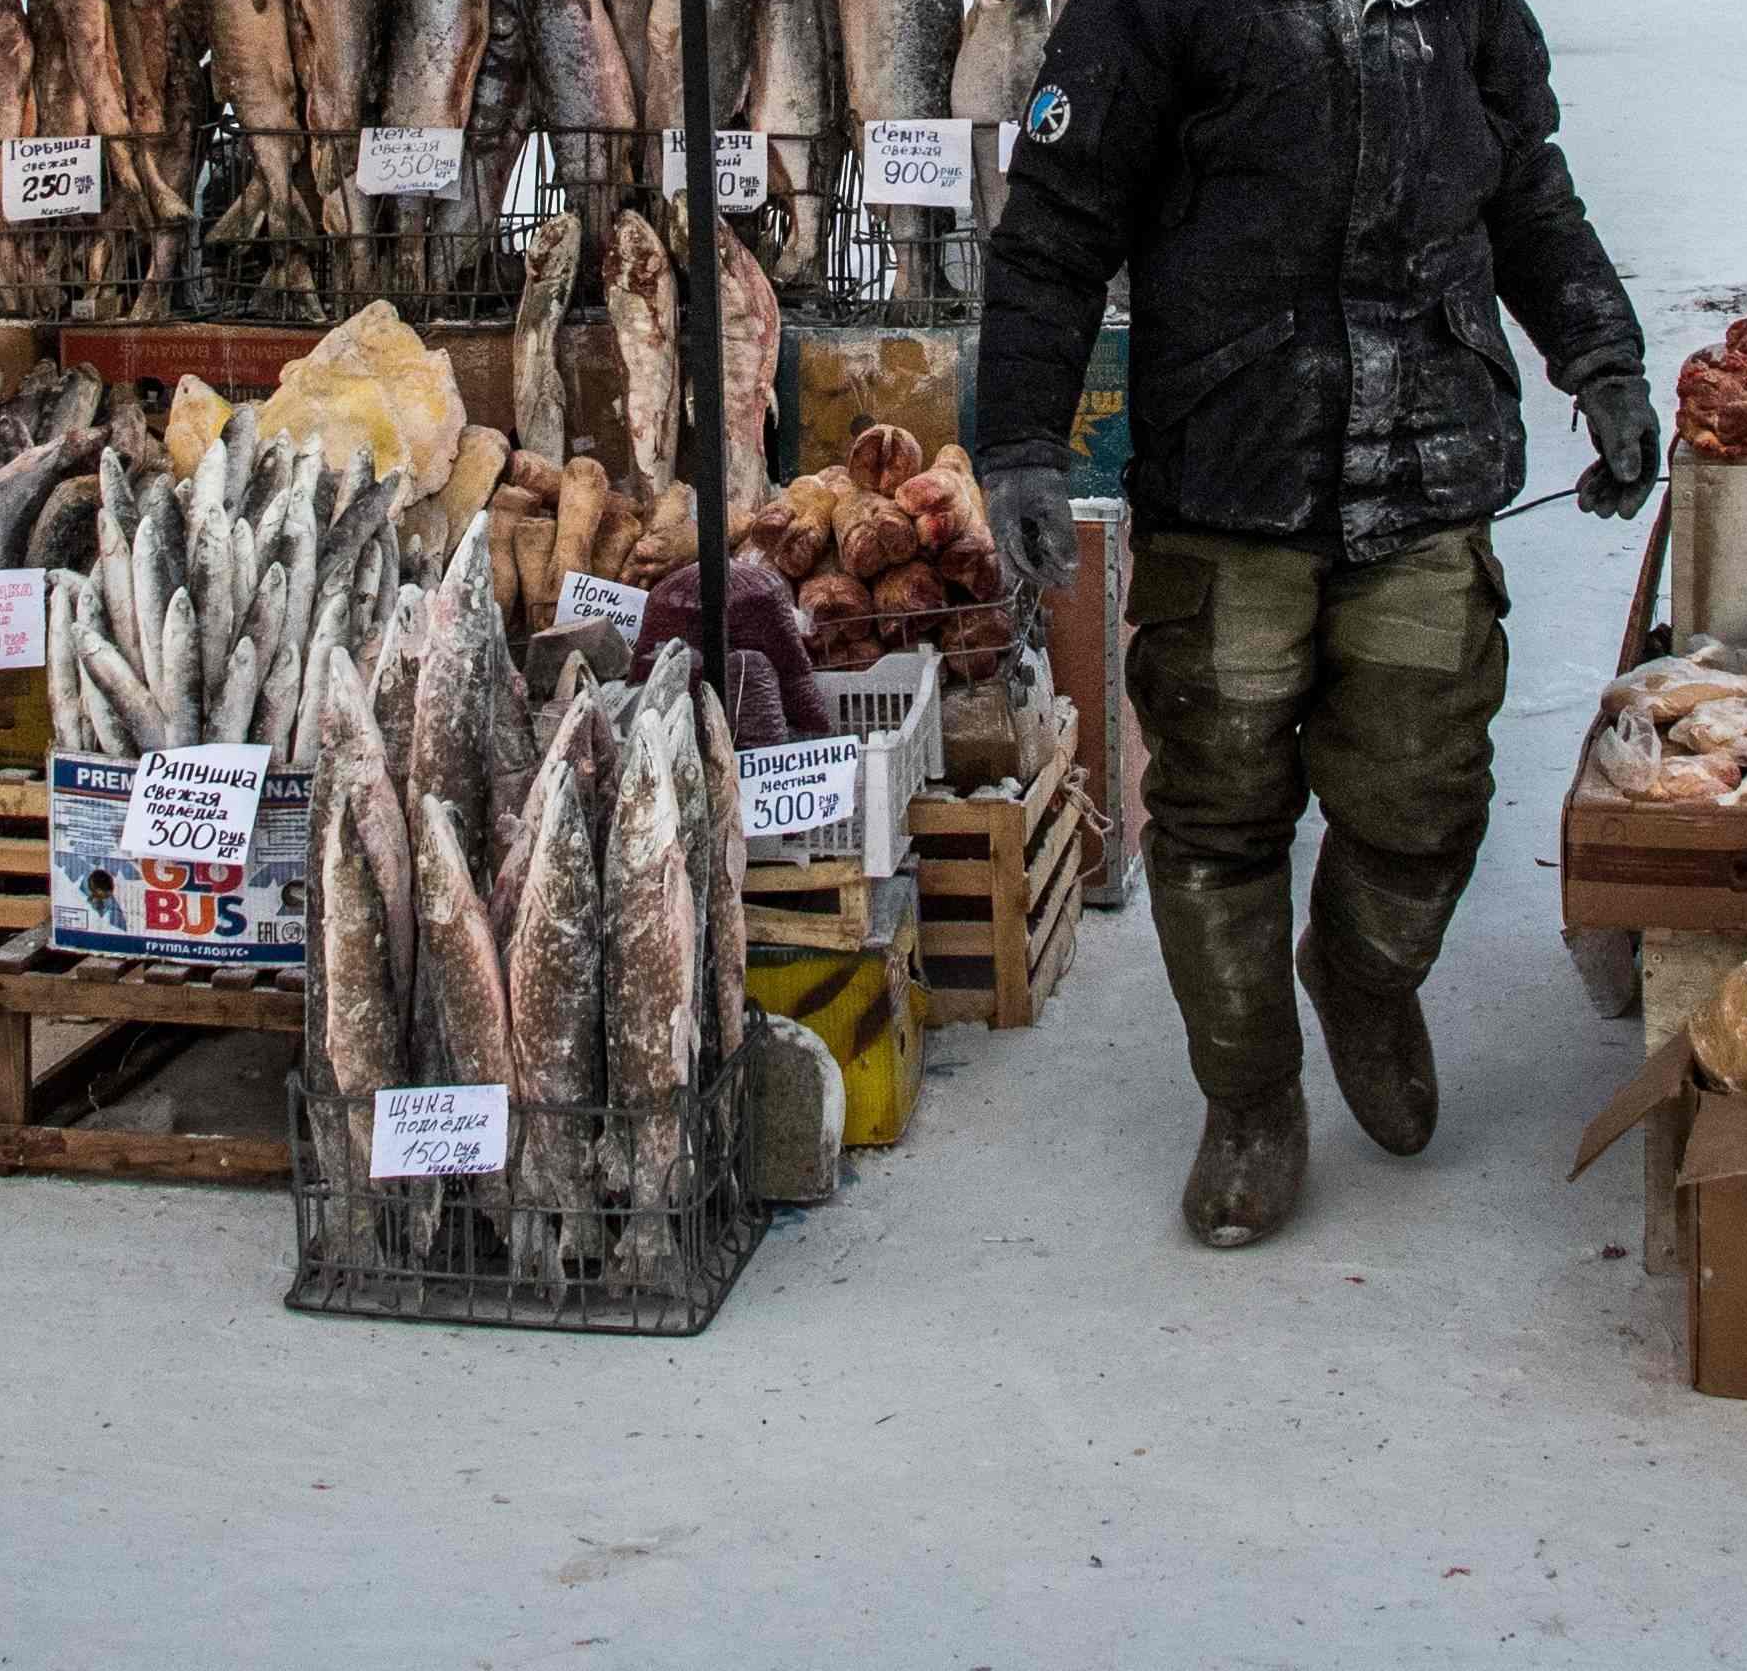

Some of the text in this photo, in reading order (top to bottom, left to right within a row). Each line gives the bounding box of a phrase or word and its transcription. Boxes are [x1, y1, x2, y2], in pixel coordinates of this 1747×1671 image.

[871, 122, 941, 143] Сёмга
[371, 141, 440, 156] свежая
[881, 145, 942, 157] свежая
[22, 157, 78, 172] свежая
[376, 153, 434, 181] 350
[884, 160, 938, 185] 900
[22, 173, 71, 203] 250
[572, 575, 622, 606] Ноги
[77, 767, 135, 791] PREM
[145, 752, 258, 791] Ряпушка
[759, 771, 827, 794] местная
[143, 783, 222, 807] свежая
[753, 791, 815, 829] 300
[148, 819, 218, 850] 300
[145, 888, 248, 937] BUS
[145, 942, 191, 955] ГРУППА
[388, 1092, 455, 1120] Щука
[402, 1139, 450, 1169] 150
